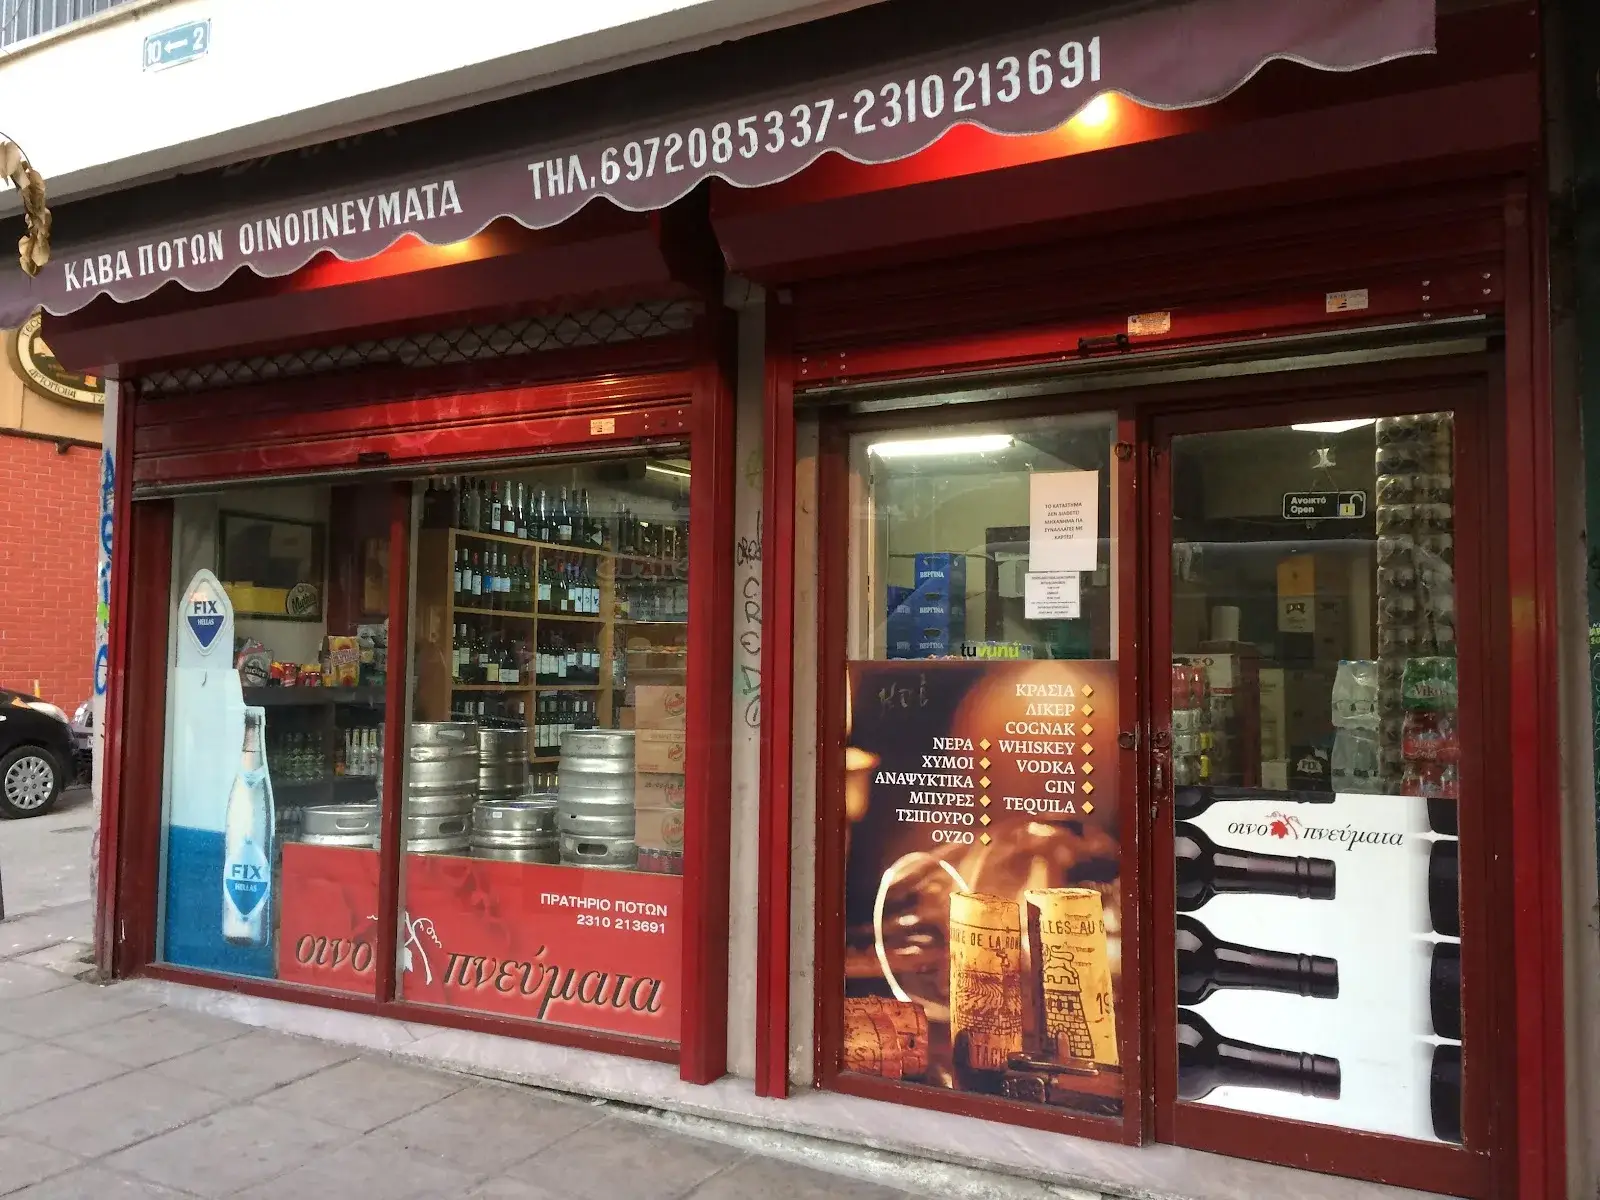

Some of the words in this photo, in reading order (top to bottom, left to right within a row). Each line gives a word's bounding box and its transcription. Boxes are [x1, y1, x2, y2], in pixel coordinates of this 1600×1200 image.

[147, 40, 162, 65] 10
[192, 26, 205, 51] 2
[63, 249, 133, 292] ΚΑΒΑ
[138, 229, 224, 276] ΠΟΤΩΝ
[239, 179, 464, 256] ΟΙΝΟΠΝΕΥΜΑΤΑ
[1290, 496, 1327, 505] Ανοικτό
[1290, 505, 1315, 514] Open
[193, 600, 218, 614] FIX
[197, 618, 215, 626] HELLAS
[1015, 683, 1075, 697] ΚΡΑΣΙΑ
[1026, 703, 1075, 717] ΛΙΚΕΡ
[1005, 721, 1076, 736] COGNAK
[932, 737, 974, 751] ΝΕΡΑ
[998, 740, 1076, 755] WHISKEY
[921, 755, 974, 770] ΧΥΜΟΙ
[1015, 760, 1076, 775] VODKA
[874, 772, 974, 789] ΑΝΑΨΥΚΤΙΚΑ
[1044, 780, 1076, 795] GIN
[909, 791, 975, 807] ΜΠΥΡΕΣ
[1002, 796, 1076, 815] TEQUILA
[896, 809, 974, 826] ΤΣΙΠΟΥΡΟ
[931, 829, 974, 845] ΟΥΖΟ
[1228, 822, 1268, 837] οινο
[1303, 824, 1404, 852] πνεύματα
[231, 863, 262, 880] FIX
[540, 893, 611, 911] ΠΡΑΤΗΡΙΟ
[614, 900, 668, 917] ΠΟΤΩΝ
[576, 914, 611, 928] 2310
[614, 918, 665, 934] 213691
[295, 932, 373, 973] οινο
[443, 944, 663, 1021] πνεύματα
